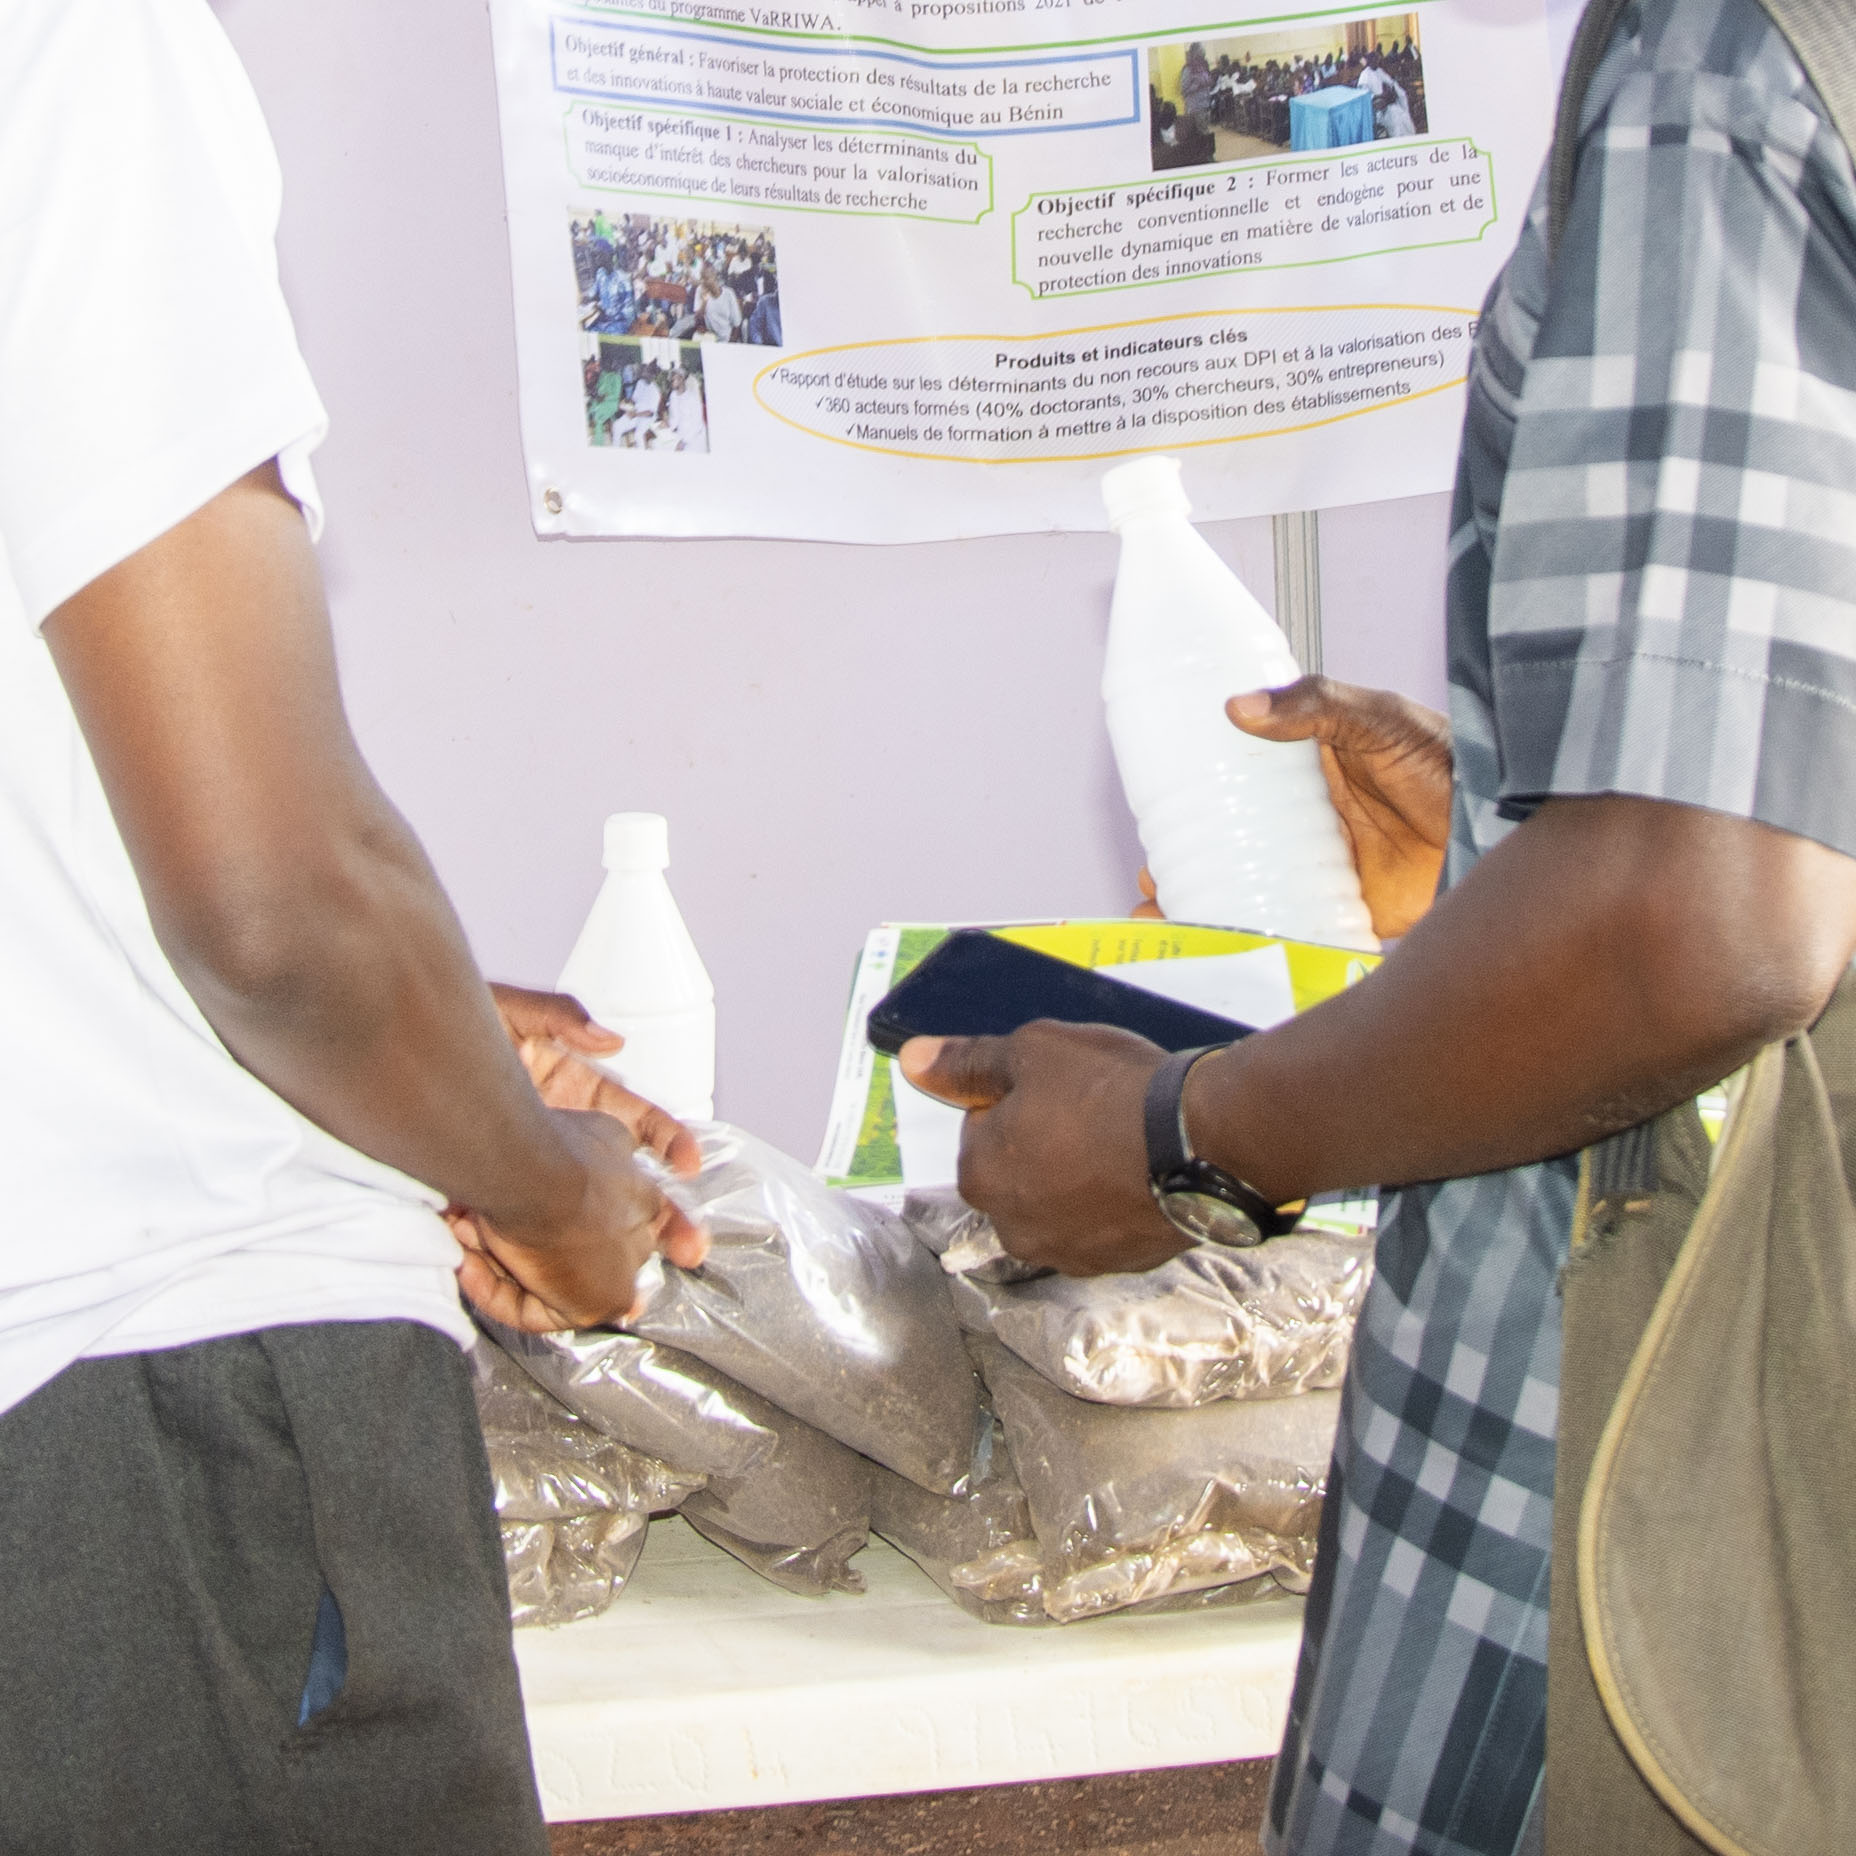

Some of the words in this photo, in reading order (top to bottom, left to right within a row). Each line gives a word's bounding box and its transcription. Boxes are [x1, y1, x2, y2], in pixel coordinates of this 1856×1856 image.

[670, 0, 745, 23] programme
[749, 9, 841, 31] VaRRIWA.
[900, 76, 967, 97] résultats
[1025, 71, 1111, 94] recherche
[872, 98, 974, 127] économique
[1009, 106, 1063, 122] Bénin
[877, 167, 978, 191] valorisation
[1037, 192, 1117, 218] Objectif
[1126, 180, 1216, 208] spécifique
[1265, 166, 1330, 187] Former
[1366, 151, 1418, 175] acteurs
[1037, 217, 1123, 242] recherche
[1137, 197, 1270, 231] conventionnelle
[1317, 183, 1385, 210] endogène
[1037, 244, 1114, 268] nouvelle
[1120, 229, 1214, 260] dynamique
[1246, 217, 1314, 242] matière
[1346, 200, 1432, 230] valorisation
[1037, 267, 1127, 297] protection
[1165, 248, 1263, 276] innovations
[780, 368, 830, 389] Rapport
[948, 375, 1067, 395] déterminants
[1137, 359, 1200, 380] recours
[1244, 350, 1277, 368] DPI
[1339, 331, 1426, 356] valorisation
[995, 352, 1076, 370] Produits
[1082, 348, 1099, 362] et
[1104, 331, 1203, 360] indicateurs
[1210, 328, 1248, 344] clés
[855, 400, 909, 415] acteurs
[914, 401, 970, 416] formés
[976, 402, 1023, 420] (40%
[1175, 375, 1280, 398] chercheurs,
[1328, 351, 1445, 382] entrepreneurs)
[856, 423, 918, 441] Manuels
[948, 424, 1033, 443] formation
[1152, 401, 1248, 427] disposition
[1291, 380, 1411, 410] établissements
